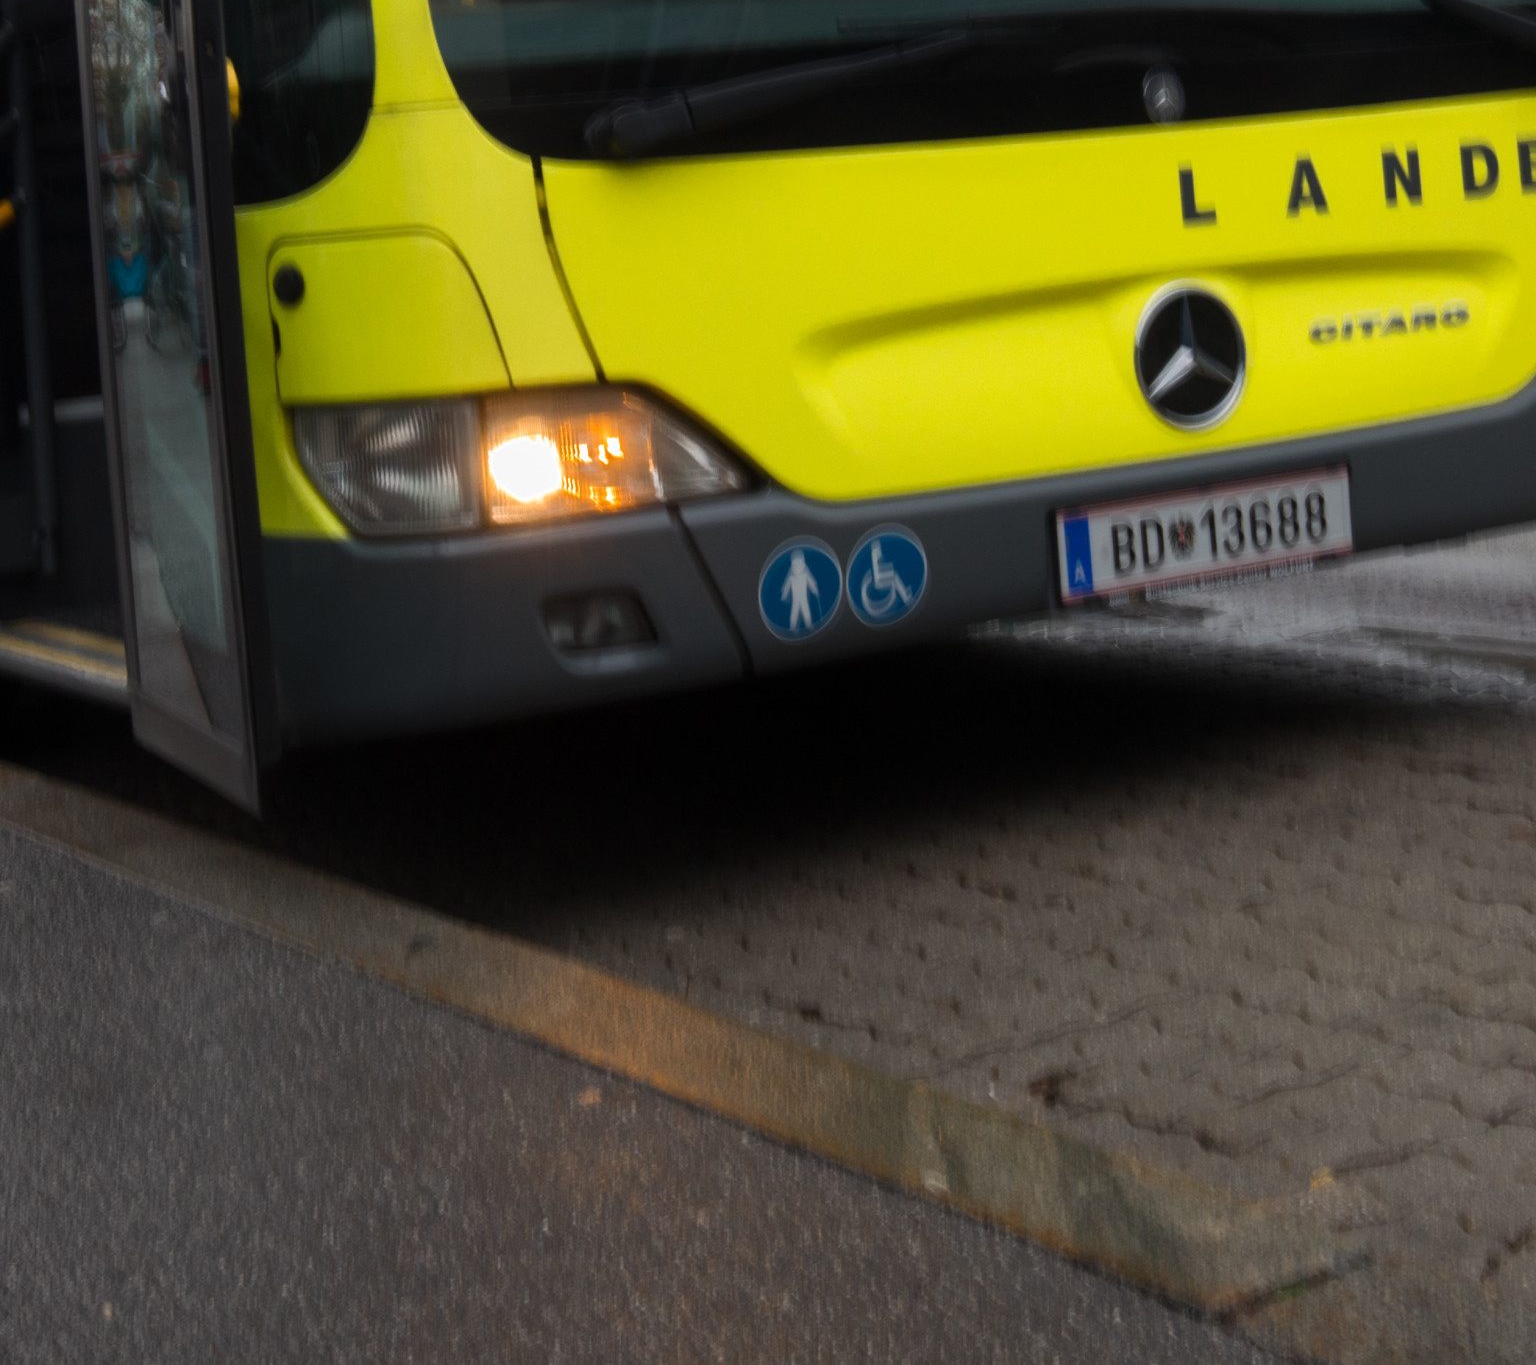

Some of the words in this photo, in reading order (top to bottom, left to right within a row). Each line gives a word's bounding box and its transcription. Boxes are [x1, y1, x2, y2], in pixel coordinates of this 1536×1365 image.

[1309, 300, 1470, 345] CITARO
[1111, 514, 1164, 575] BD
[1201, 489, 1327, 562] 13688
[1074, 559, 1087, 585] A
